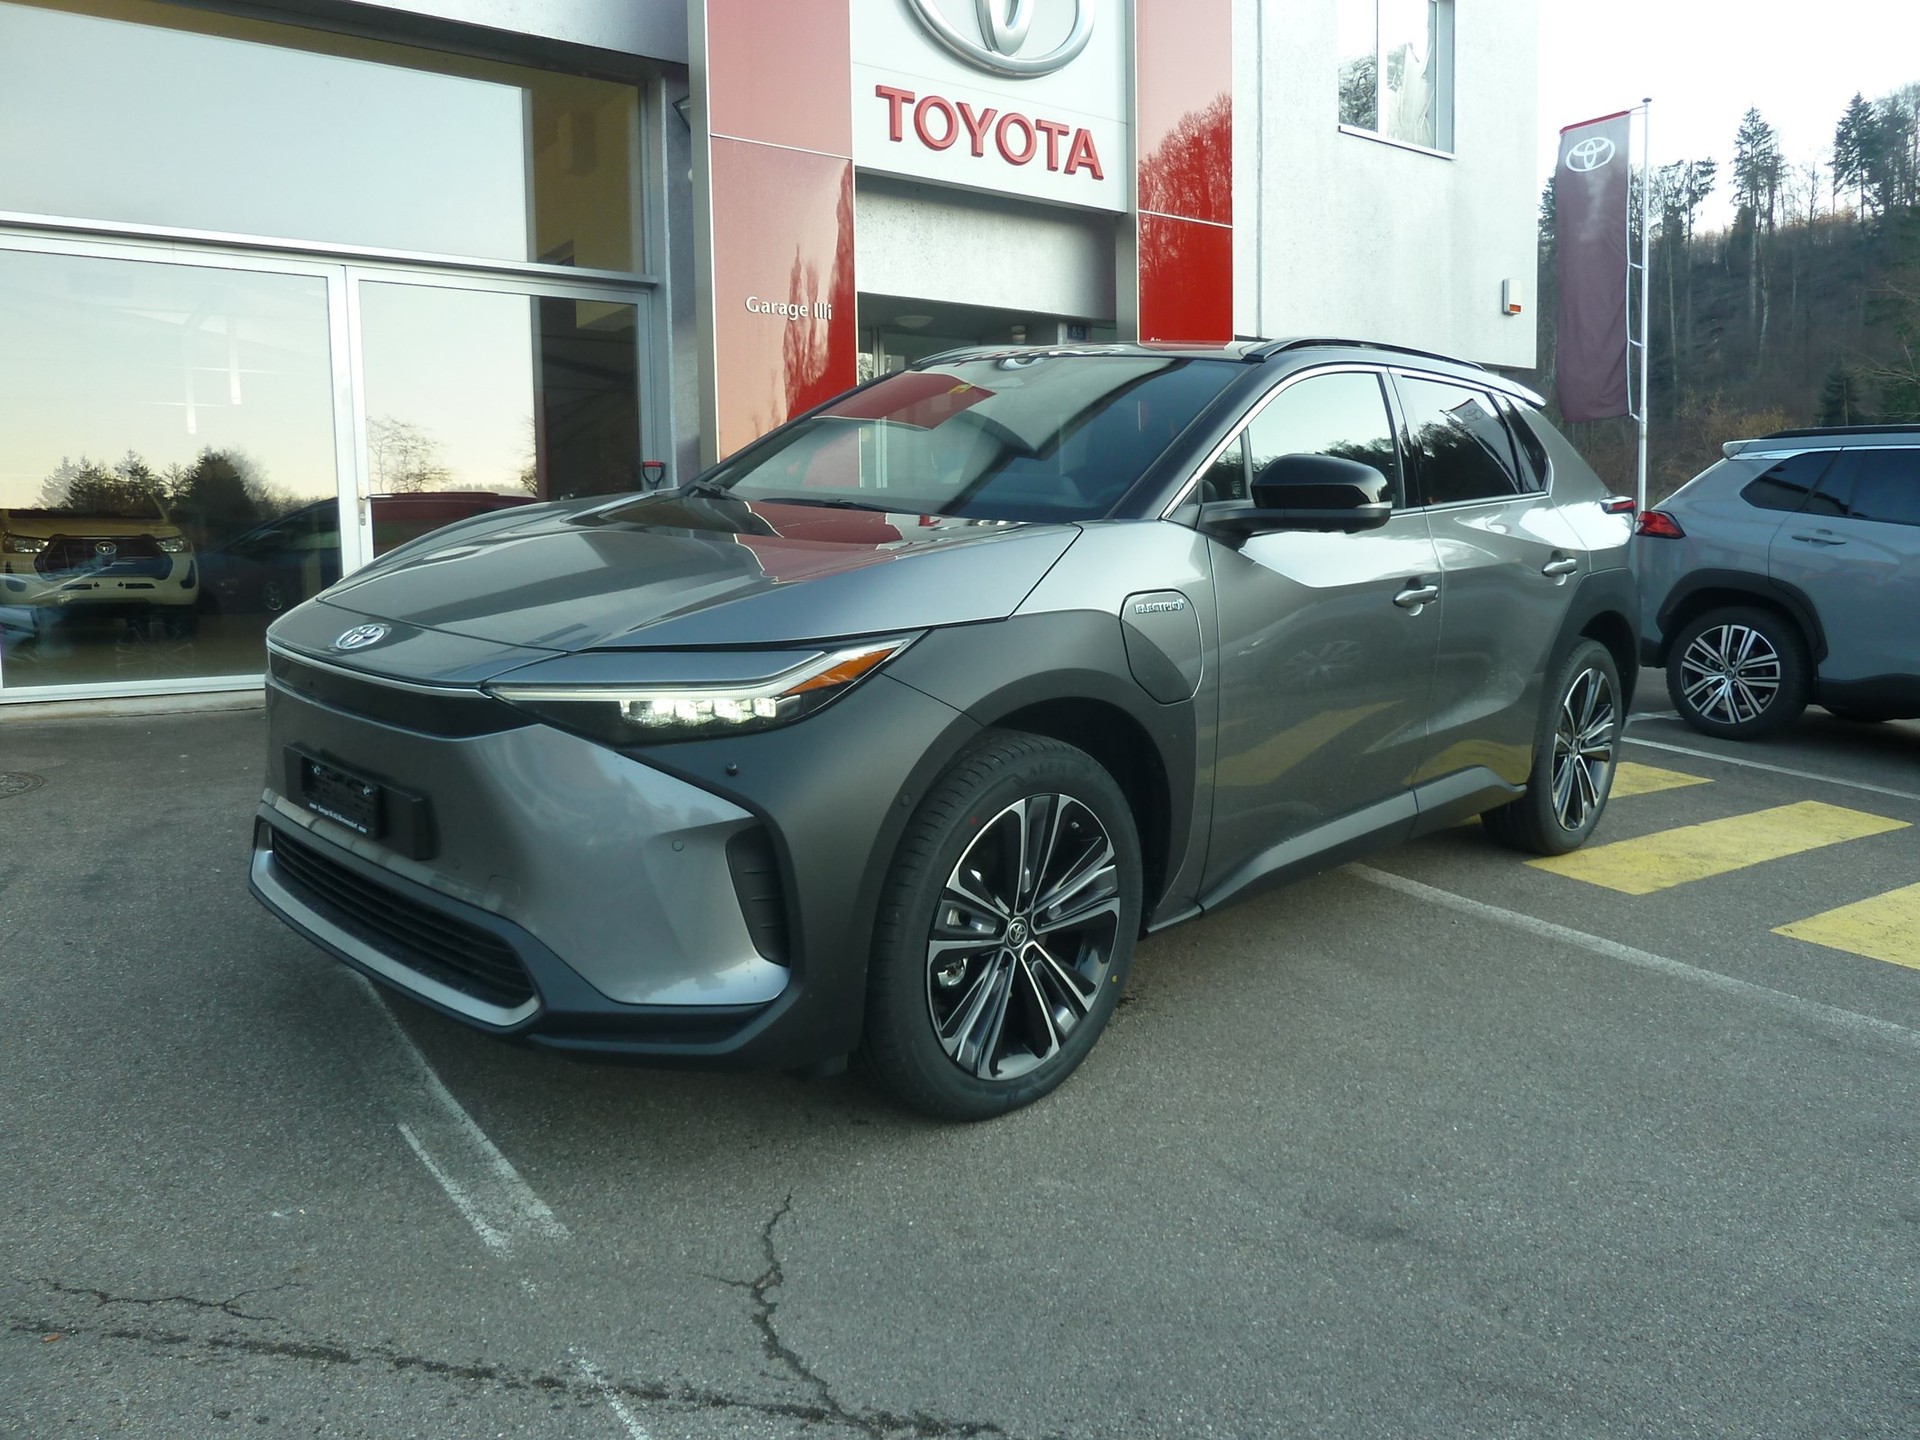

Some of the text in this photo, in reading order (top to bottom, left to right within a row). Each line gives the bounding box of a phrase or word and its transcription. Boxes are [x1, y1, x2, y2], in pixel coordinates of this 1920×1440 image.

[875, 84, 1105, 181] TOYOTA
[745, 296, 832, 321] Garage Illi
